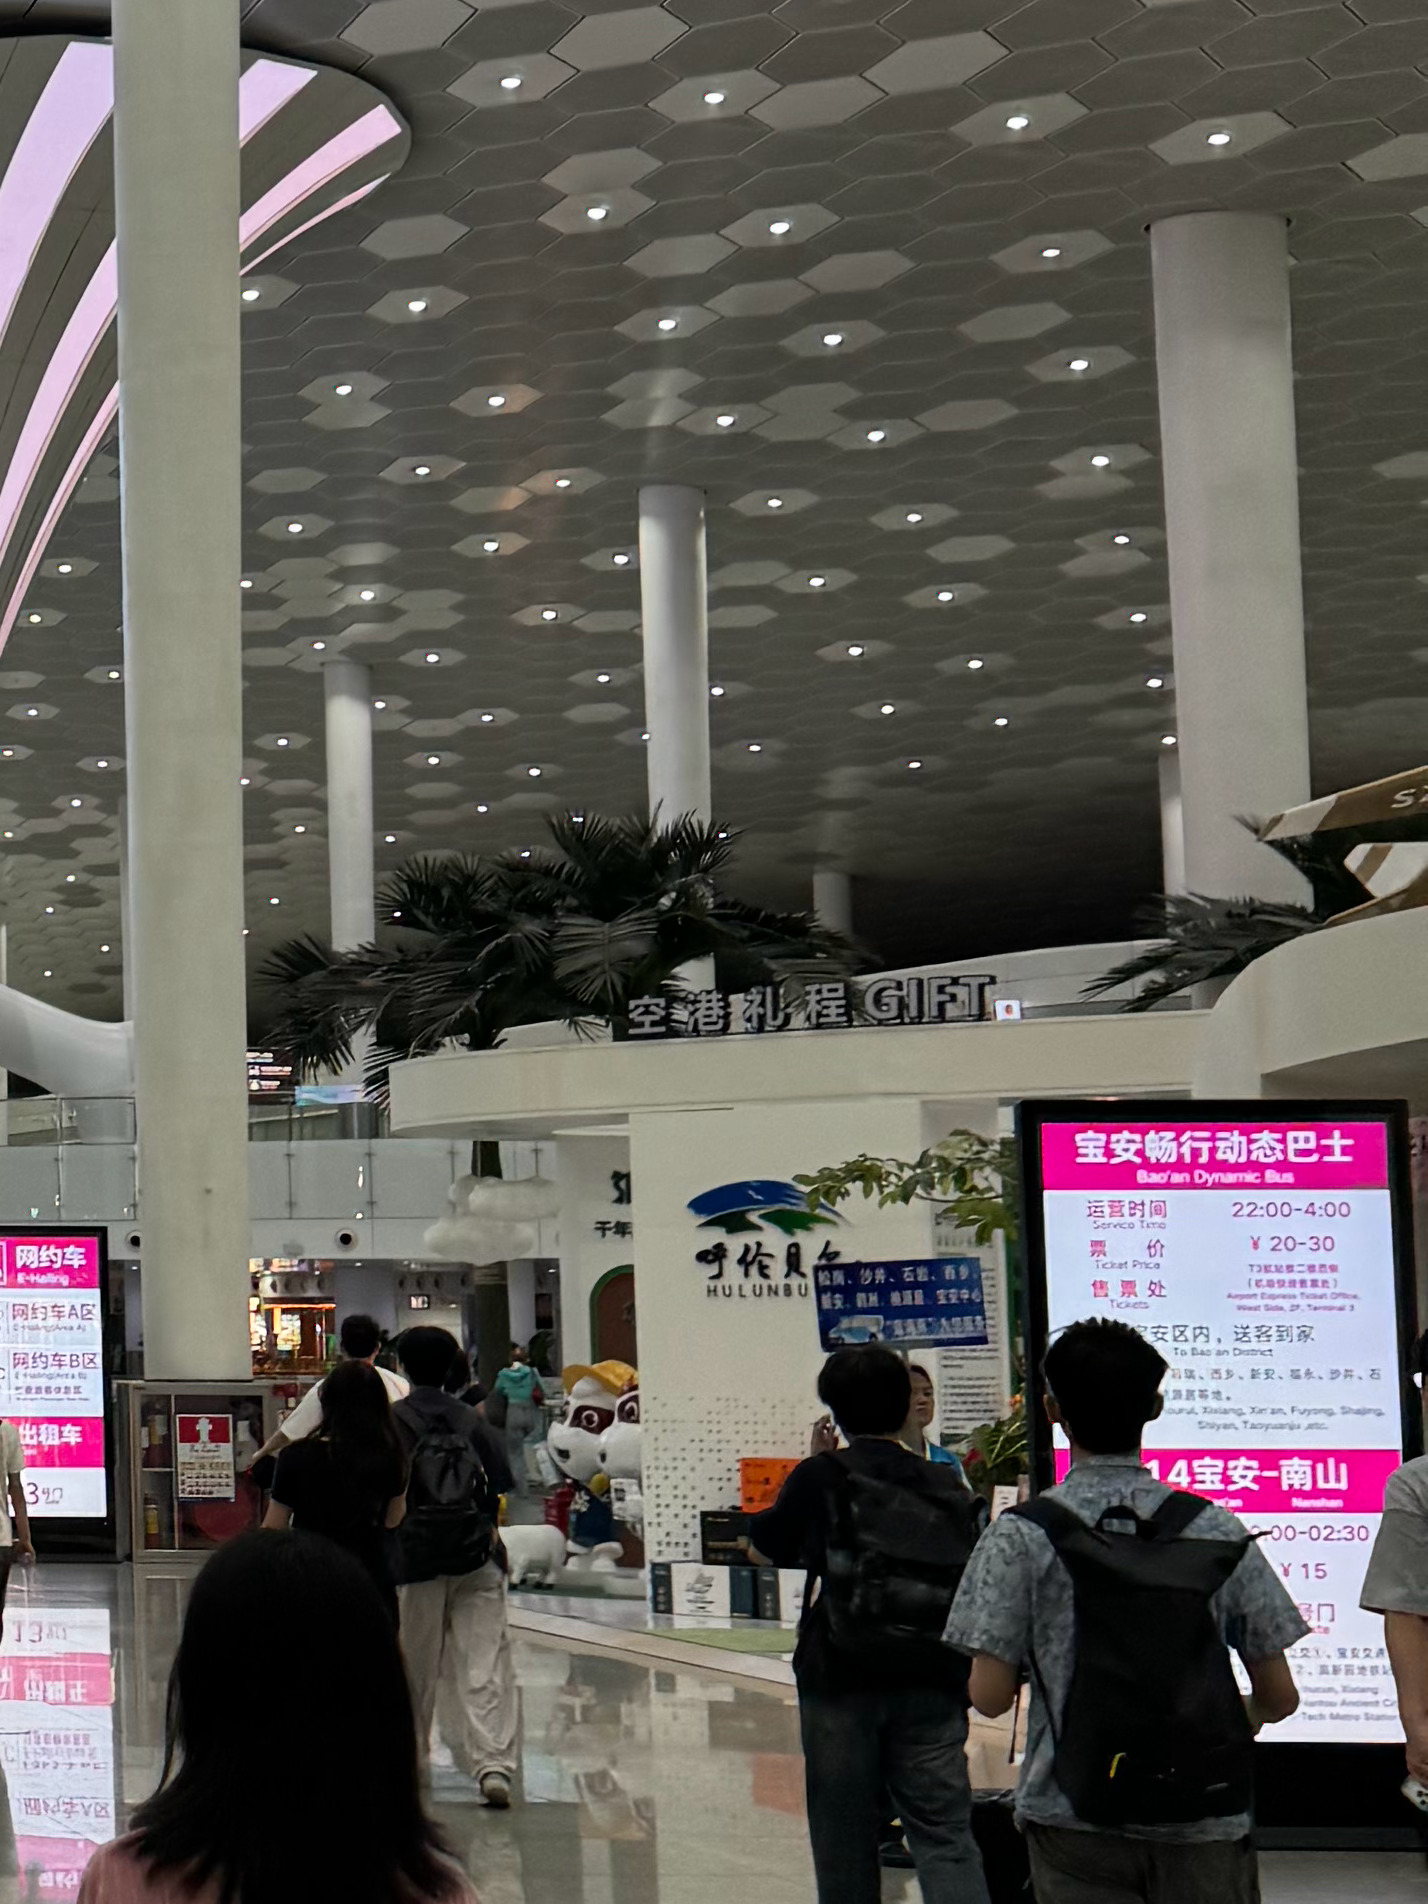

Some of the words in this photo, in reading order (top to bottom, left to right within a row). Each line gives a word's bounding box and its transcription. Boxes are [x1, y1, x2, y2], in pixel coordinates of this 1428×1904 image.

[864, 975, 996, 1022] GIFT
[1074, 1130, 1356, 1165] 宝安畅行动态巴士
[1136, 1169, 1191, 1184] Bao'an
[1194, 1170, 1261, 1187] Dynamic
[1264, 1169, 1295, 1184] Bus
[1087, 1199, 1168, 1219] 运营时间
[1232, 1201, 1351, 1218] 22:00-4:00
[1250, 1236, 1261, 1251] ¥
[1270, 1235, 1335, 1252] 20-30
[15, 1245, 87, 1269] 网约车
[1095, 1260, 1128, 1270] Ticket
[17, 1272, 70, 1286] E-Hailing
[12, 1302, 96, 1321] 网约车A区
[1109, 1299, 1150, 1309] Tickets
[12, 1351, 99, 1370] 网约车B区
[1172, 1347, 1188, 1357] To
[18, 1423, 84, 1446] 出租车
[1291, 1497, 1344, 1508] Nanshan
[1280, 1562, 1292, 1578] ¥
[1301, 1562, 1328, 1580] 15
